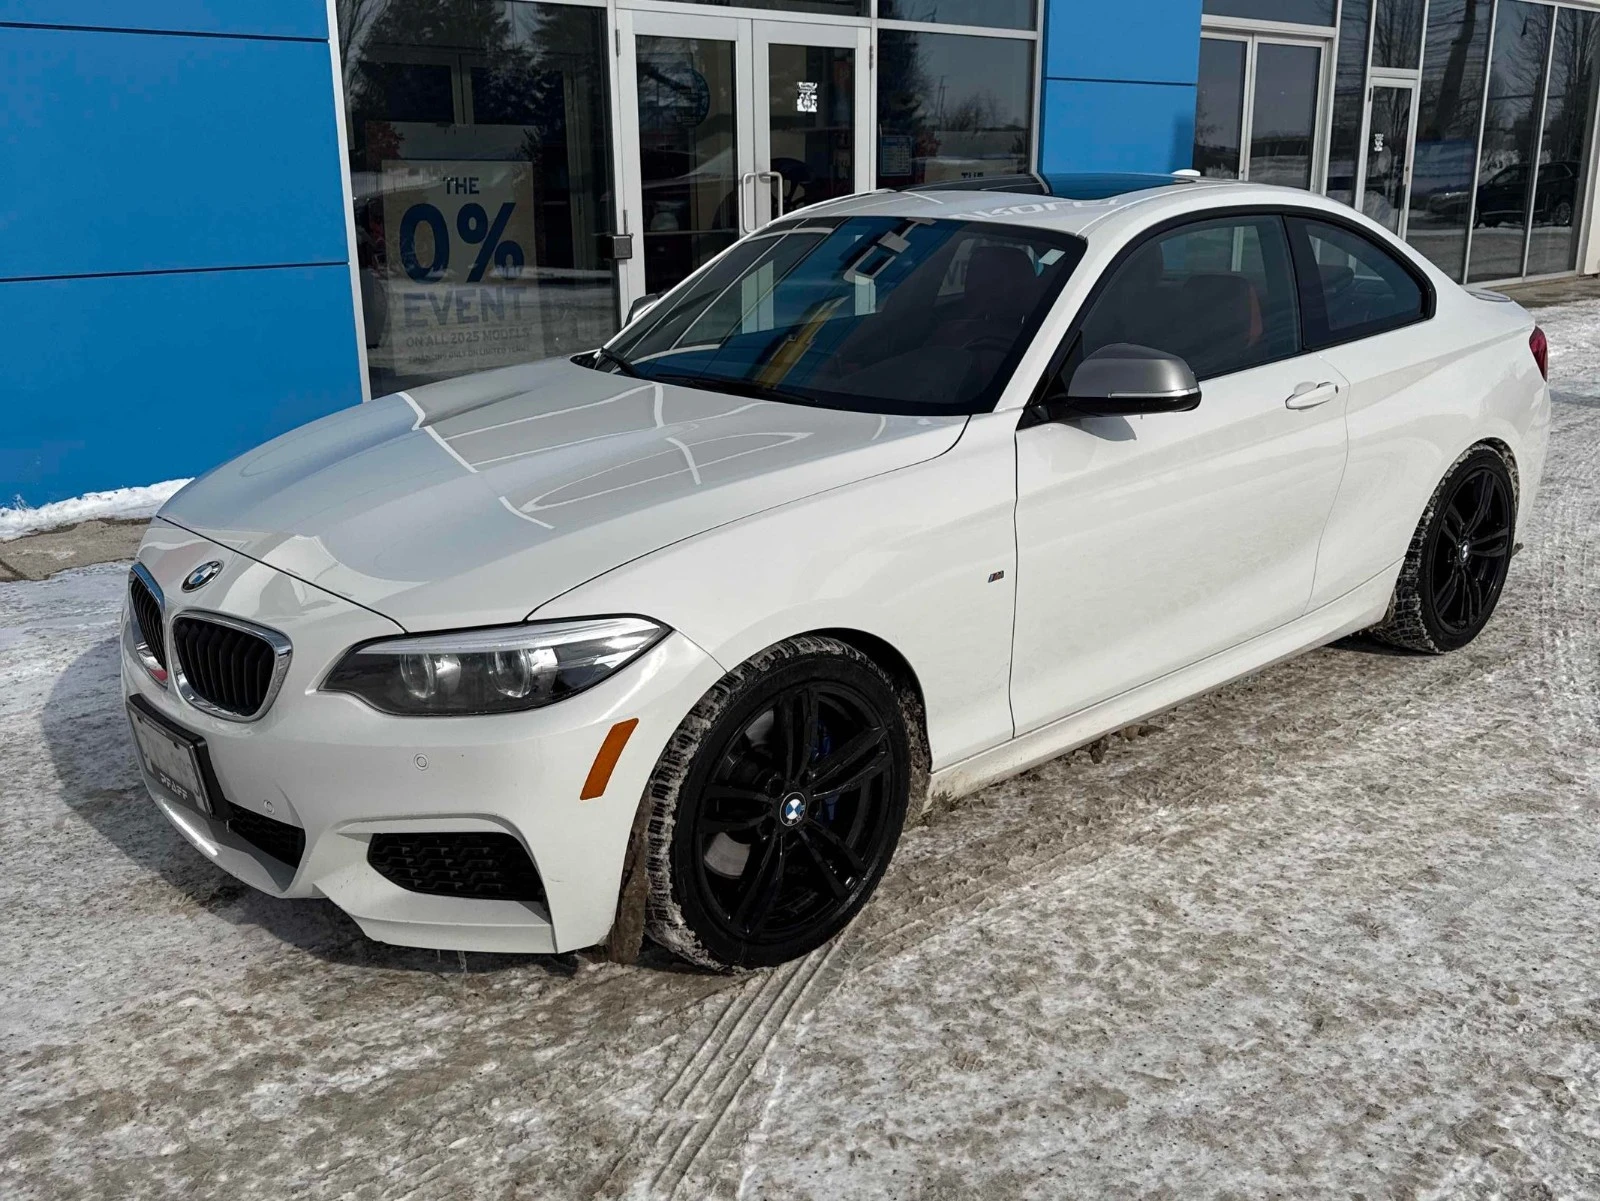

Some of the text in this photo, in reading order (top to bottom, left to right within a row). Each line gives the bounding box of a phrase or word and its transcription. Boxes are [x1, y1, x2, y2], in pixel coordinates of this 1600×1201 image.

[443, 176, 480, 195] THE
[399, 202, 525, 284] 0%
[403, 286, 528, 328] EVENT
[406, 336, 424, 347] ON
[426, 333, 449, 346] ALL
[450, 330, 480, 345] 2025
[159, 772, 188, 800] PFAFF
